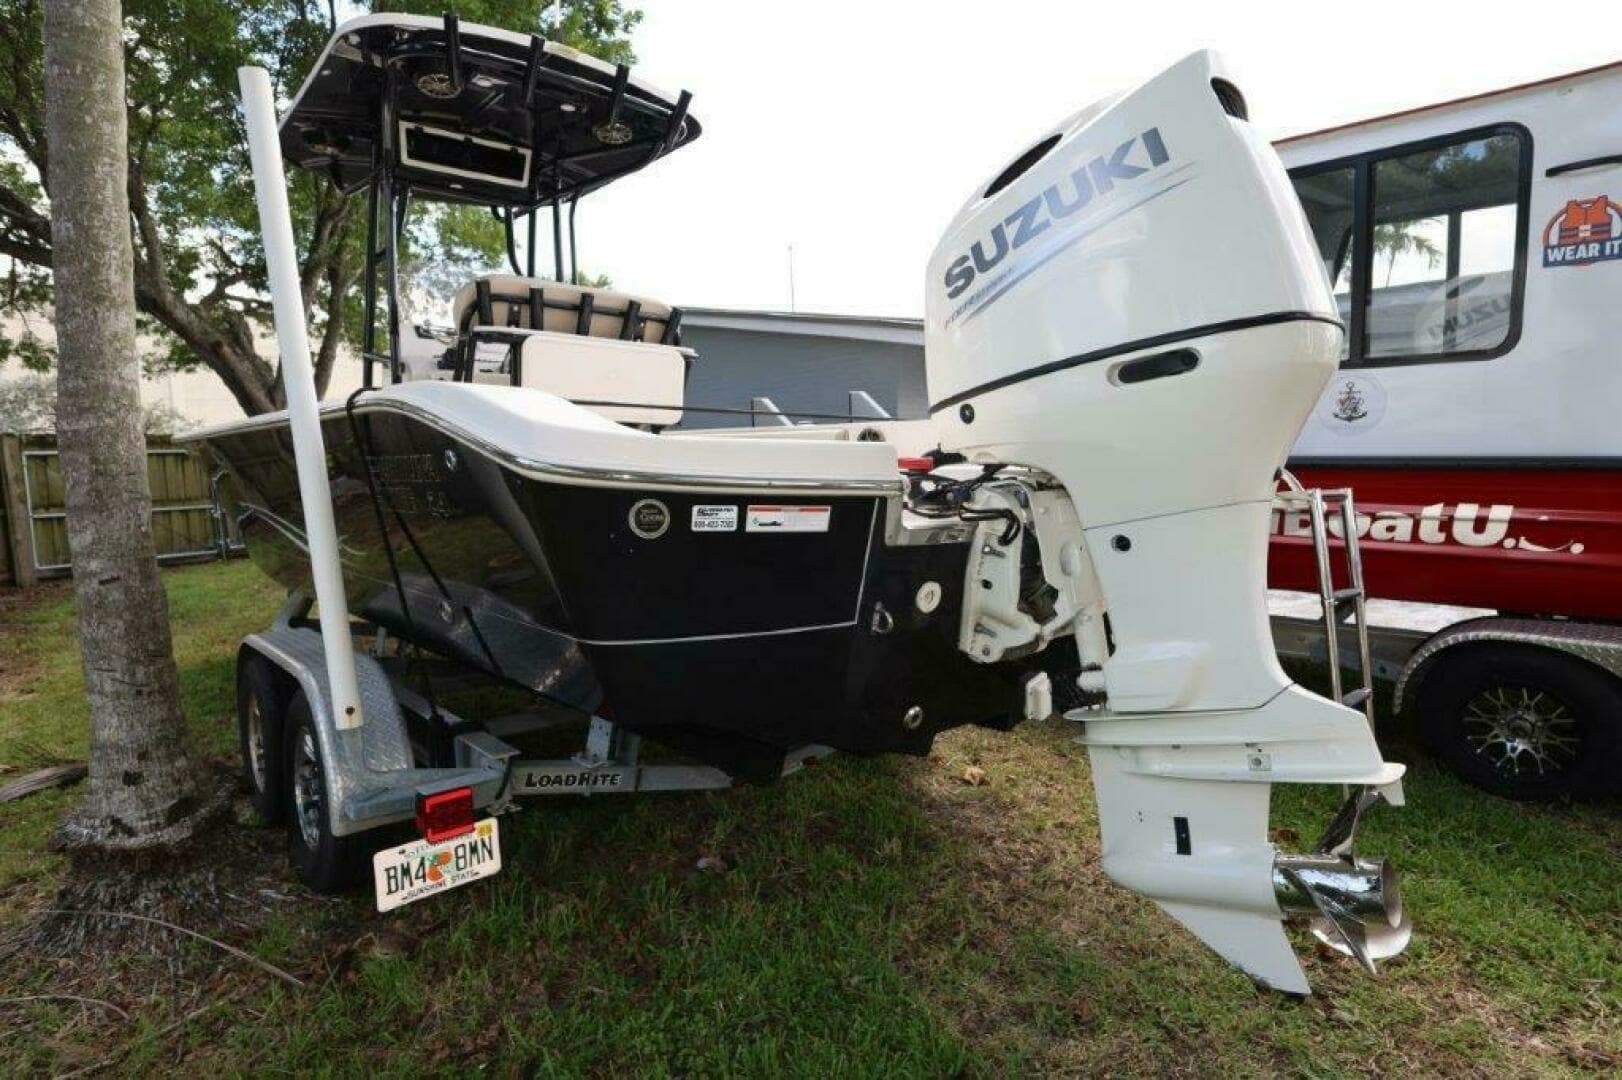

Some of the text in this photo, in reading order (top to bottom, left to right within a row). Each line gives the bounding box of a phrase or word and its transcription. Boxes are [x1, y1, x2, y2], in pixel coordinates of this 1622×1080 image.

[944, 127, 1170, 300] SUZUKI
[1547, 240, 1622, 262] WEAR IT
[385, 856, 427, 896] BM4
